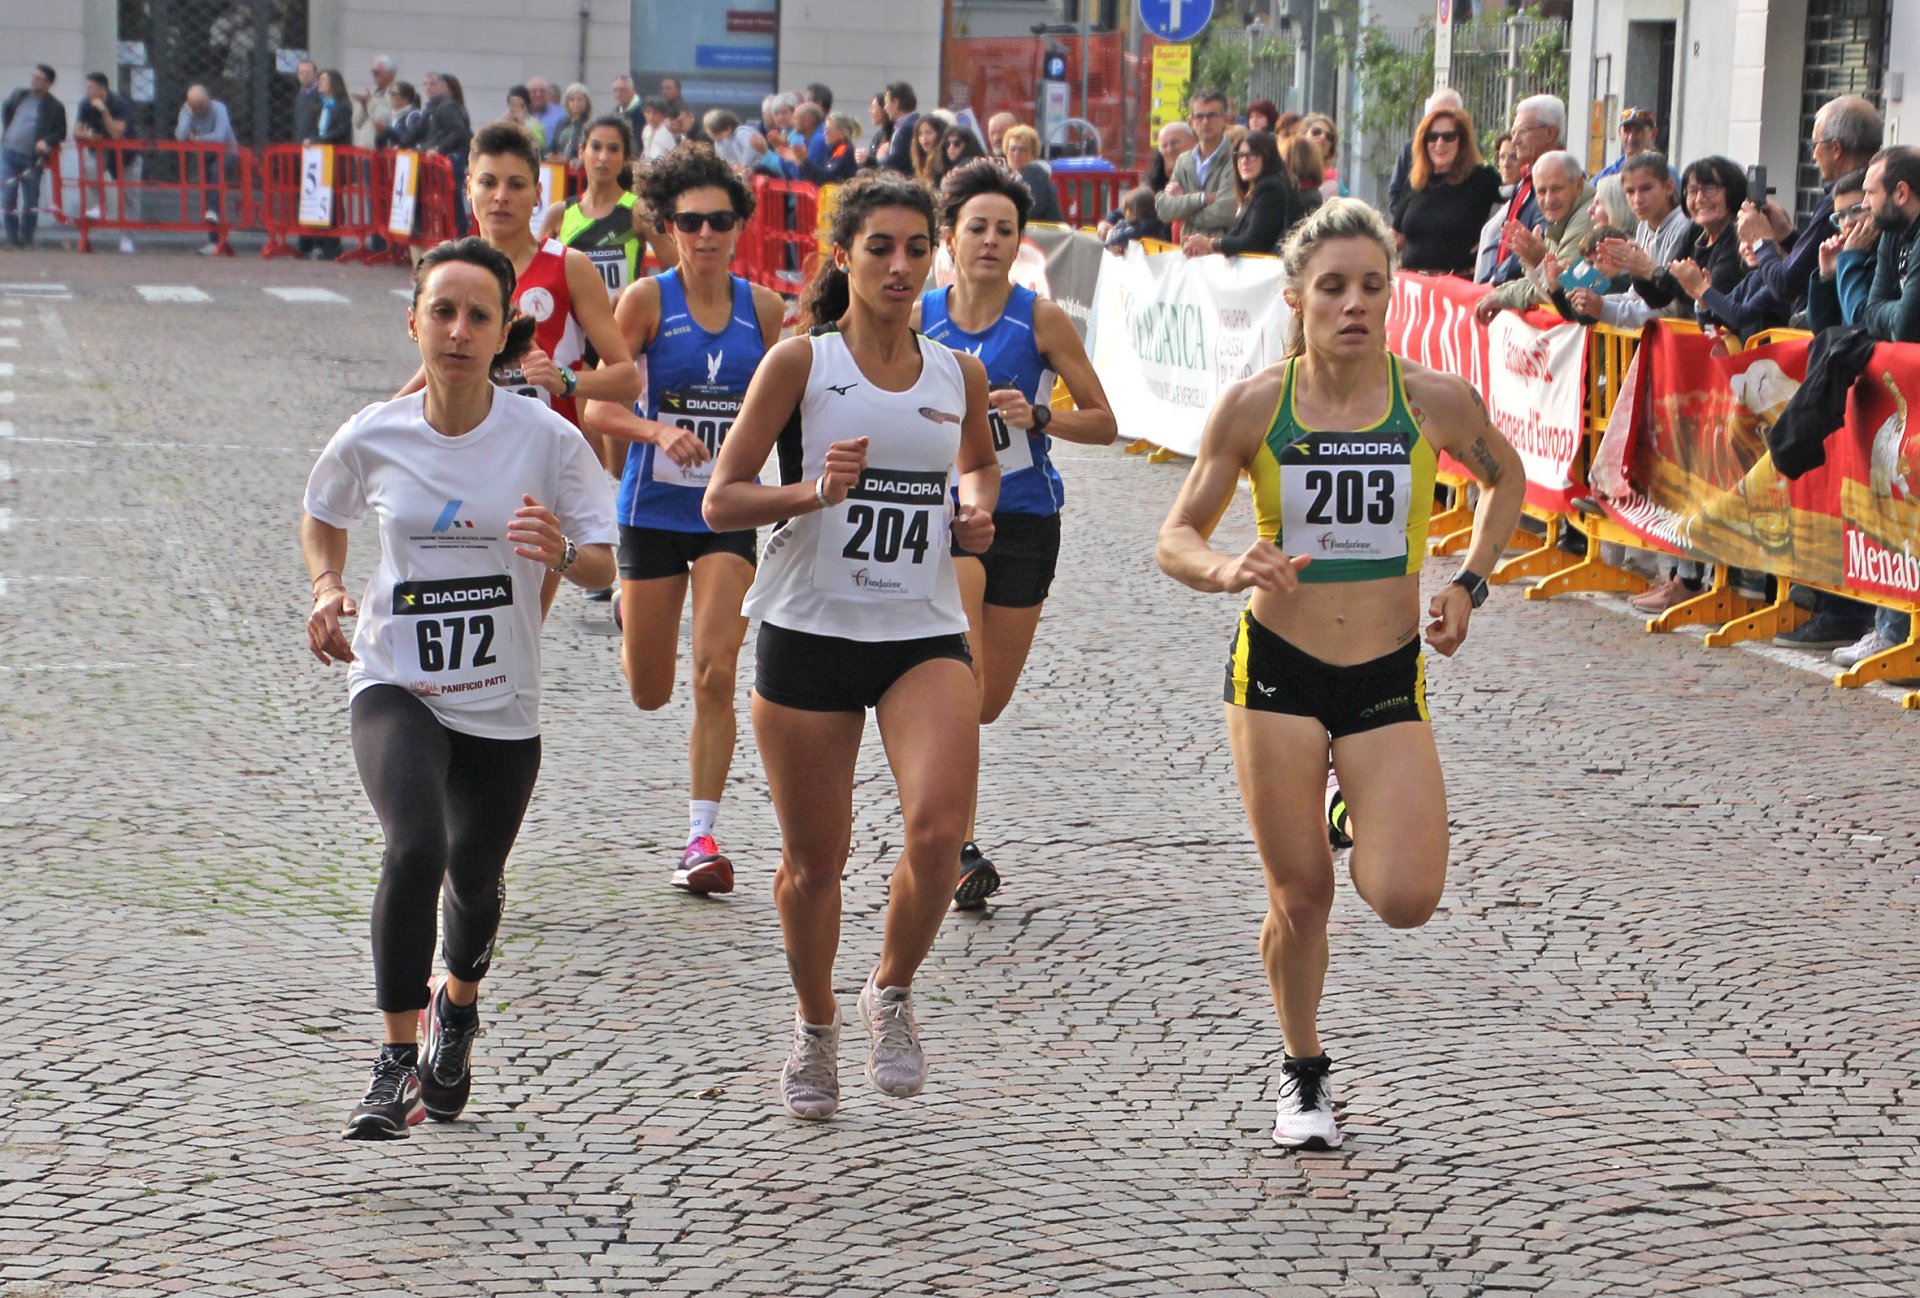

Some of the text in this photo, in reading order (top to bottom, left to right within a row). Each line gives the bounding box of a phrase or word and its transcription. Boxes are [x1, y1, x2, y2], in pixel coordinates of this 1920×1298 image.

[305, 162, 317, 195] 5
[1319, 443, 1406, 455] DIADORA
[864, 479, 942, 496] DIADORA
[1305, 470, 1395, 525] 203
[842, 504, 929, 565] 204
[1846, 529, 1920, 593] Menab
[423, 586, 507, 605] DIADORA
[864, 576, 902, 589] Fondazione
[416, 614, 496, 673] 672
[441, 675, 506, 694] PANIFICIO PATTI
